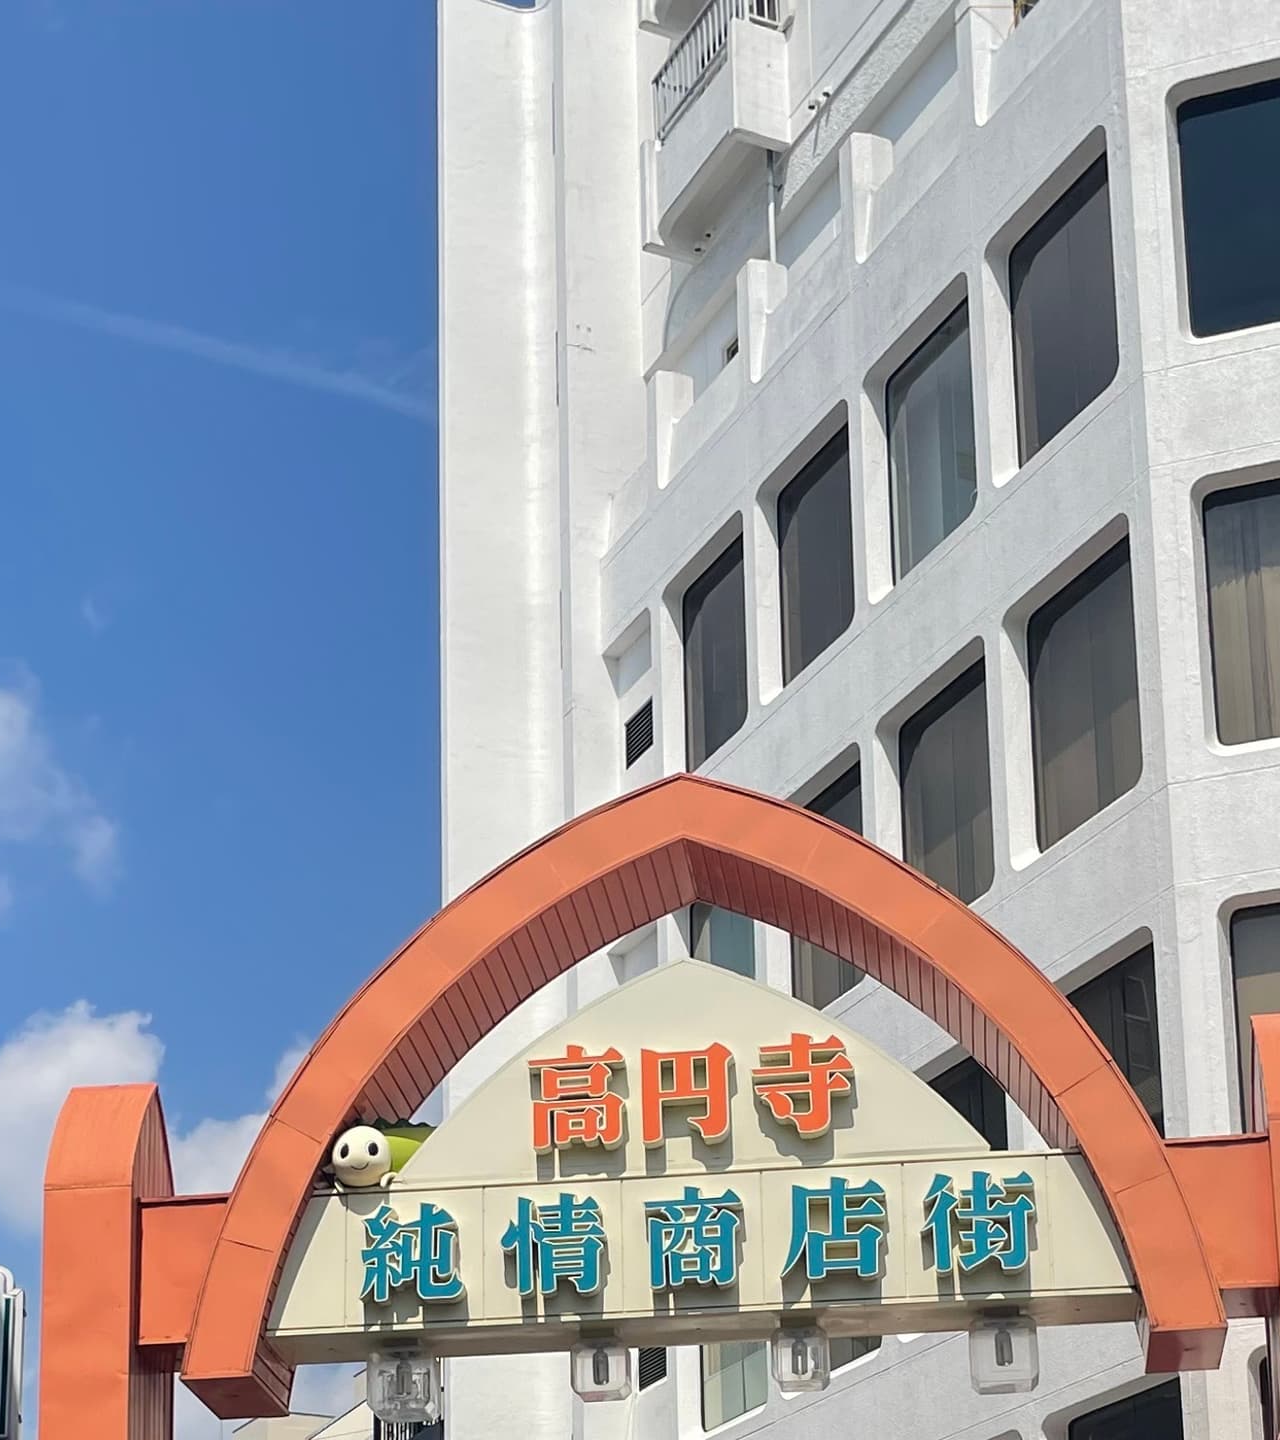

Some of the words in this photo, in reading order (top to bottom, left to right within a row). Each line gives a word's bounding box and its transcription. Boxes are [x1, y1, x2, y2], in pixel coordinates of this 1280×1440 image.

[527, 1032, 857, 1155] 高円寺
[358, 1169, 1035, 1307] 純情商店街
